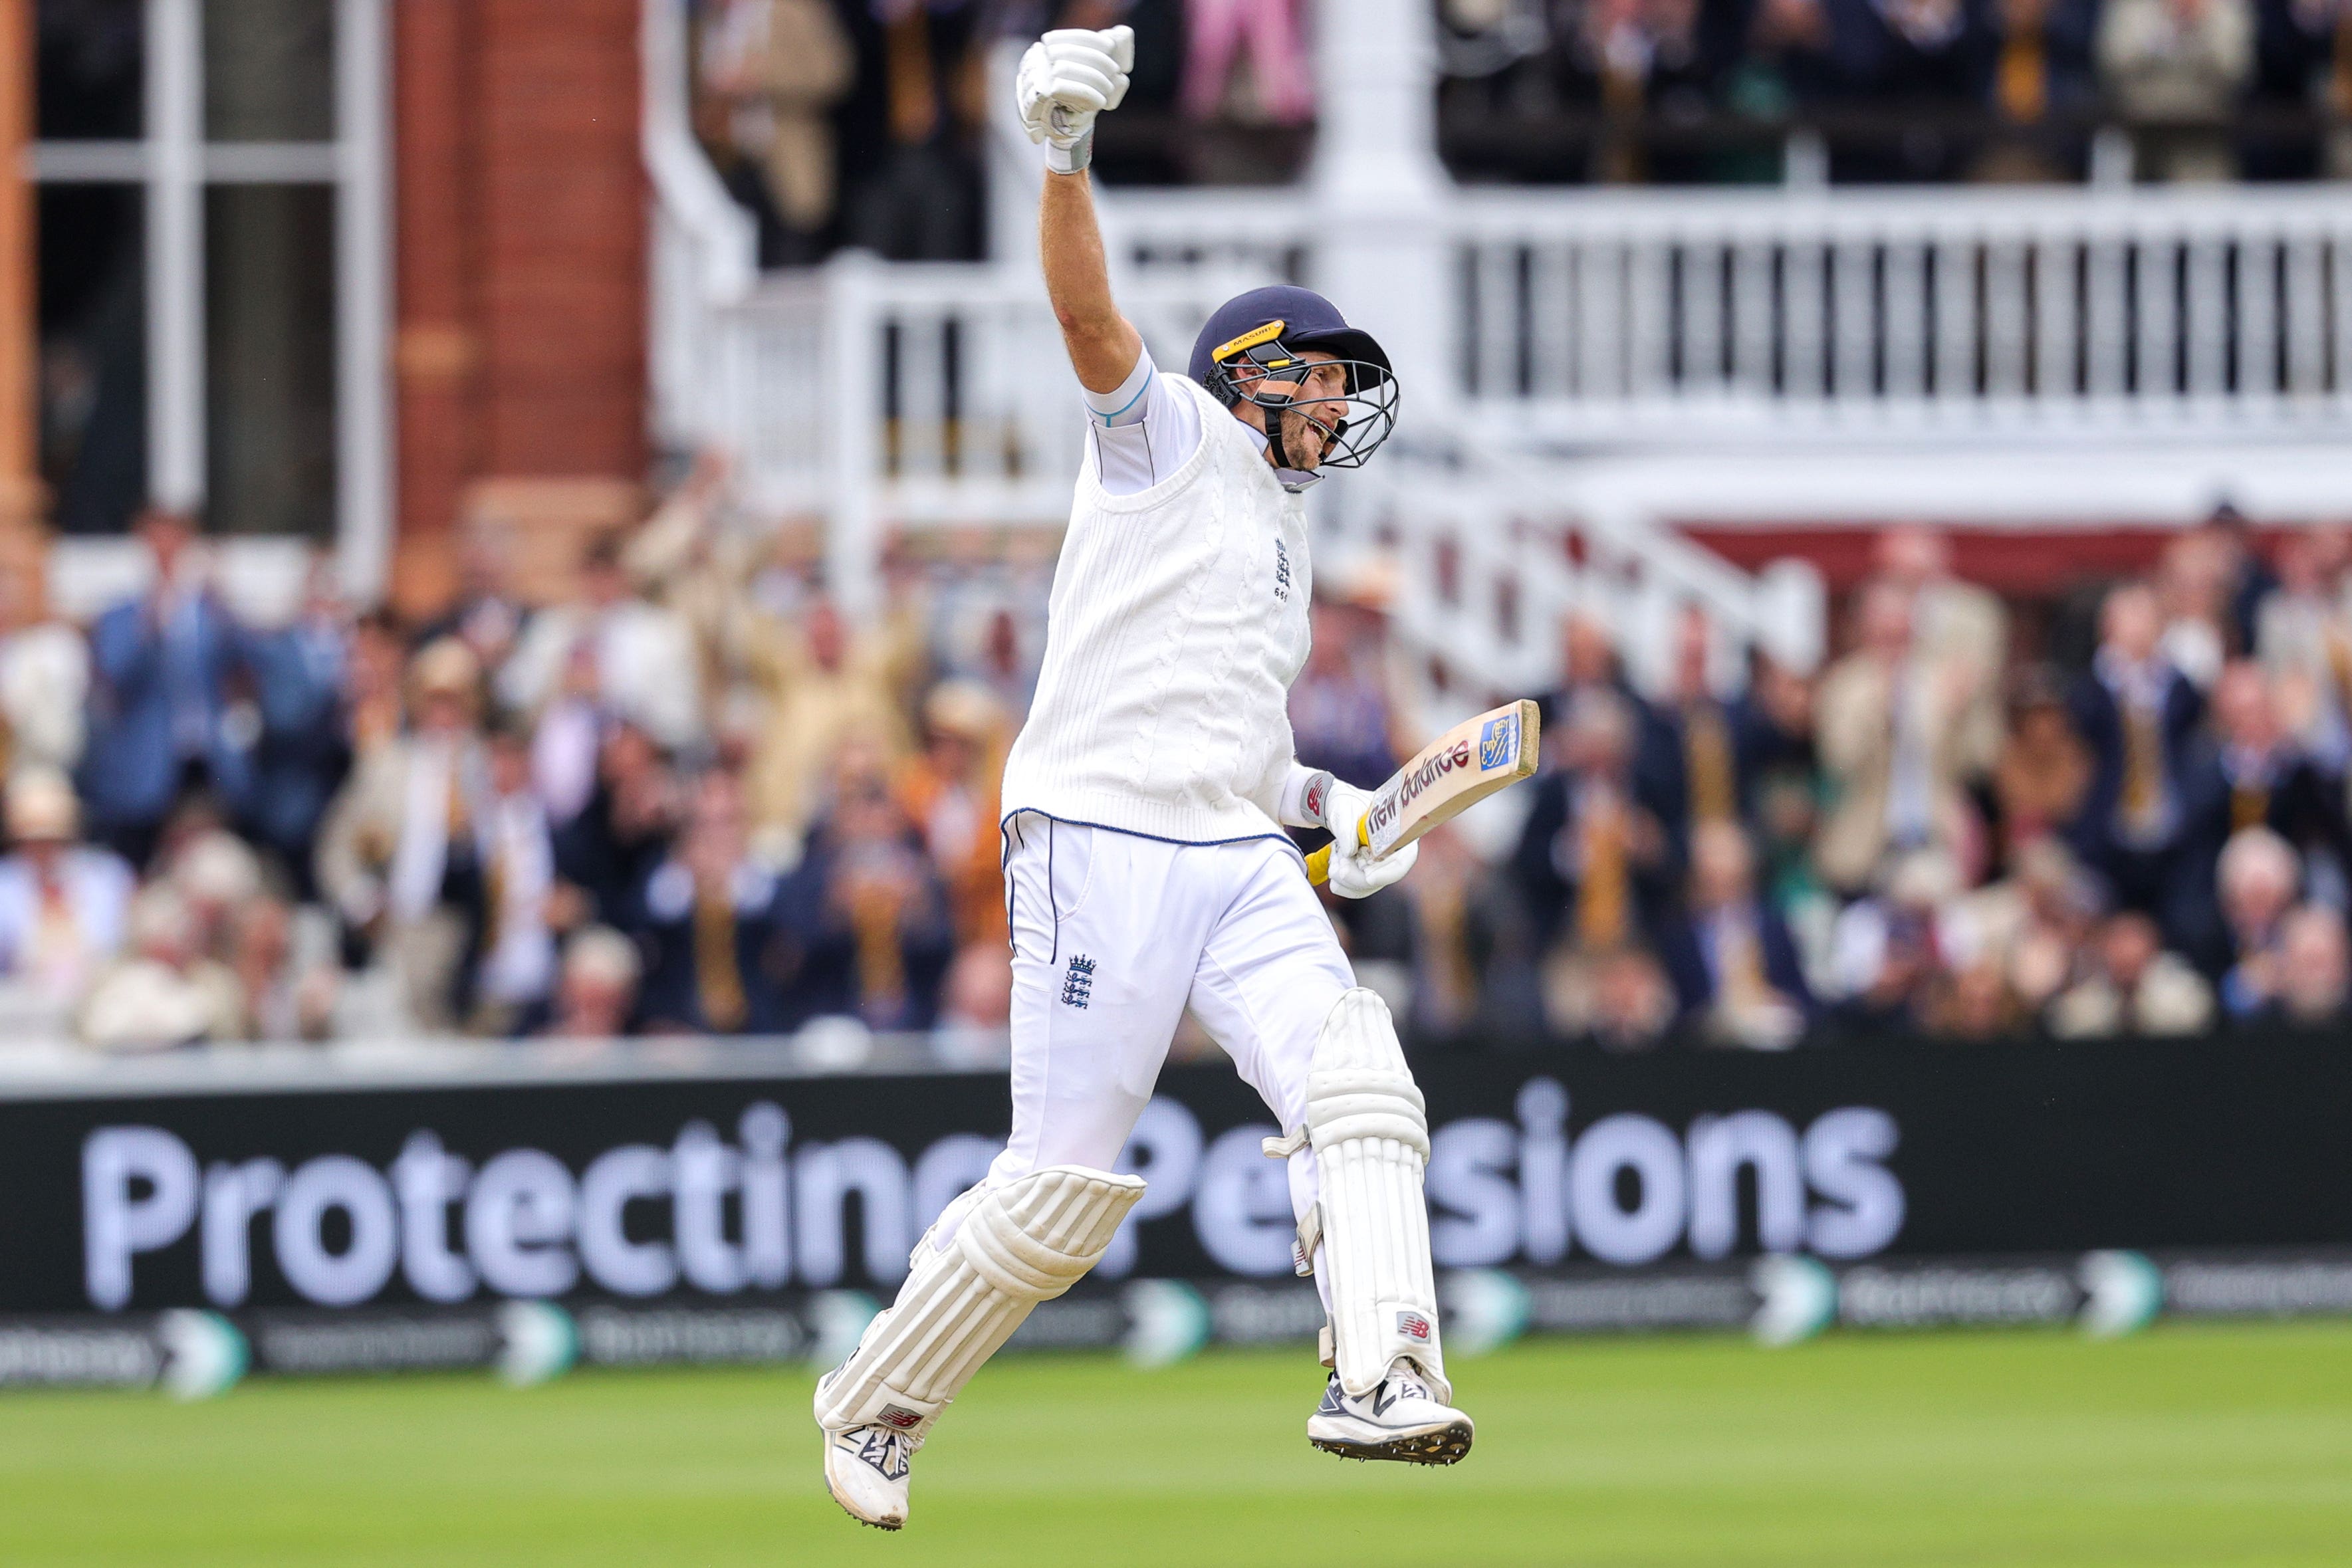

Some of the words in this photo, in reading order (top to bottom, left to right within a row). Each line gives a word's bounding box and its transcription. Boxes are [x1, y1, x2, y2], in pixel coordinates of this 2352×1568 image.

[1233, 327, 1271, 346] MASURI
[1368, 787, 1400, 835] new
[1401, 740, 1469, 808] balance
[81, 1101, 1008, 1311] Protectin
[1090, 1075, 1907, 1279] Pesions
